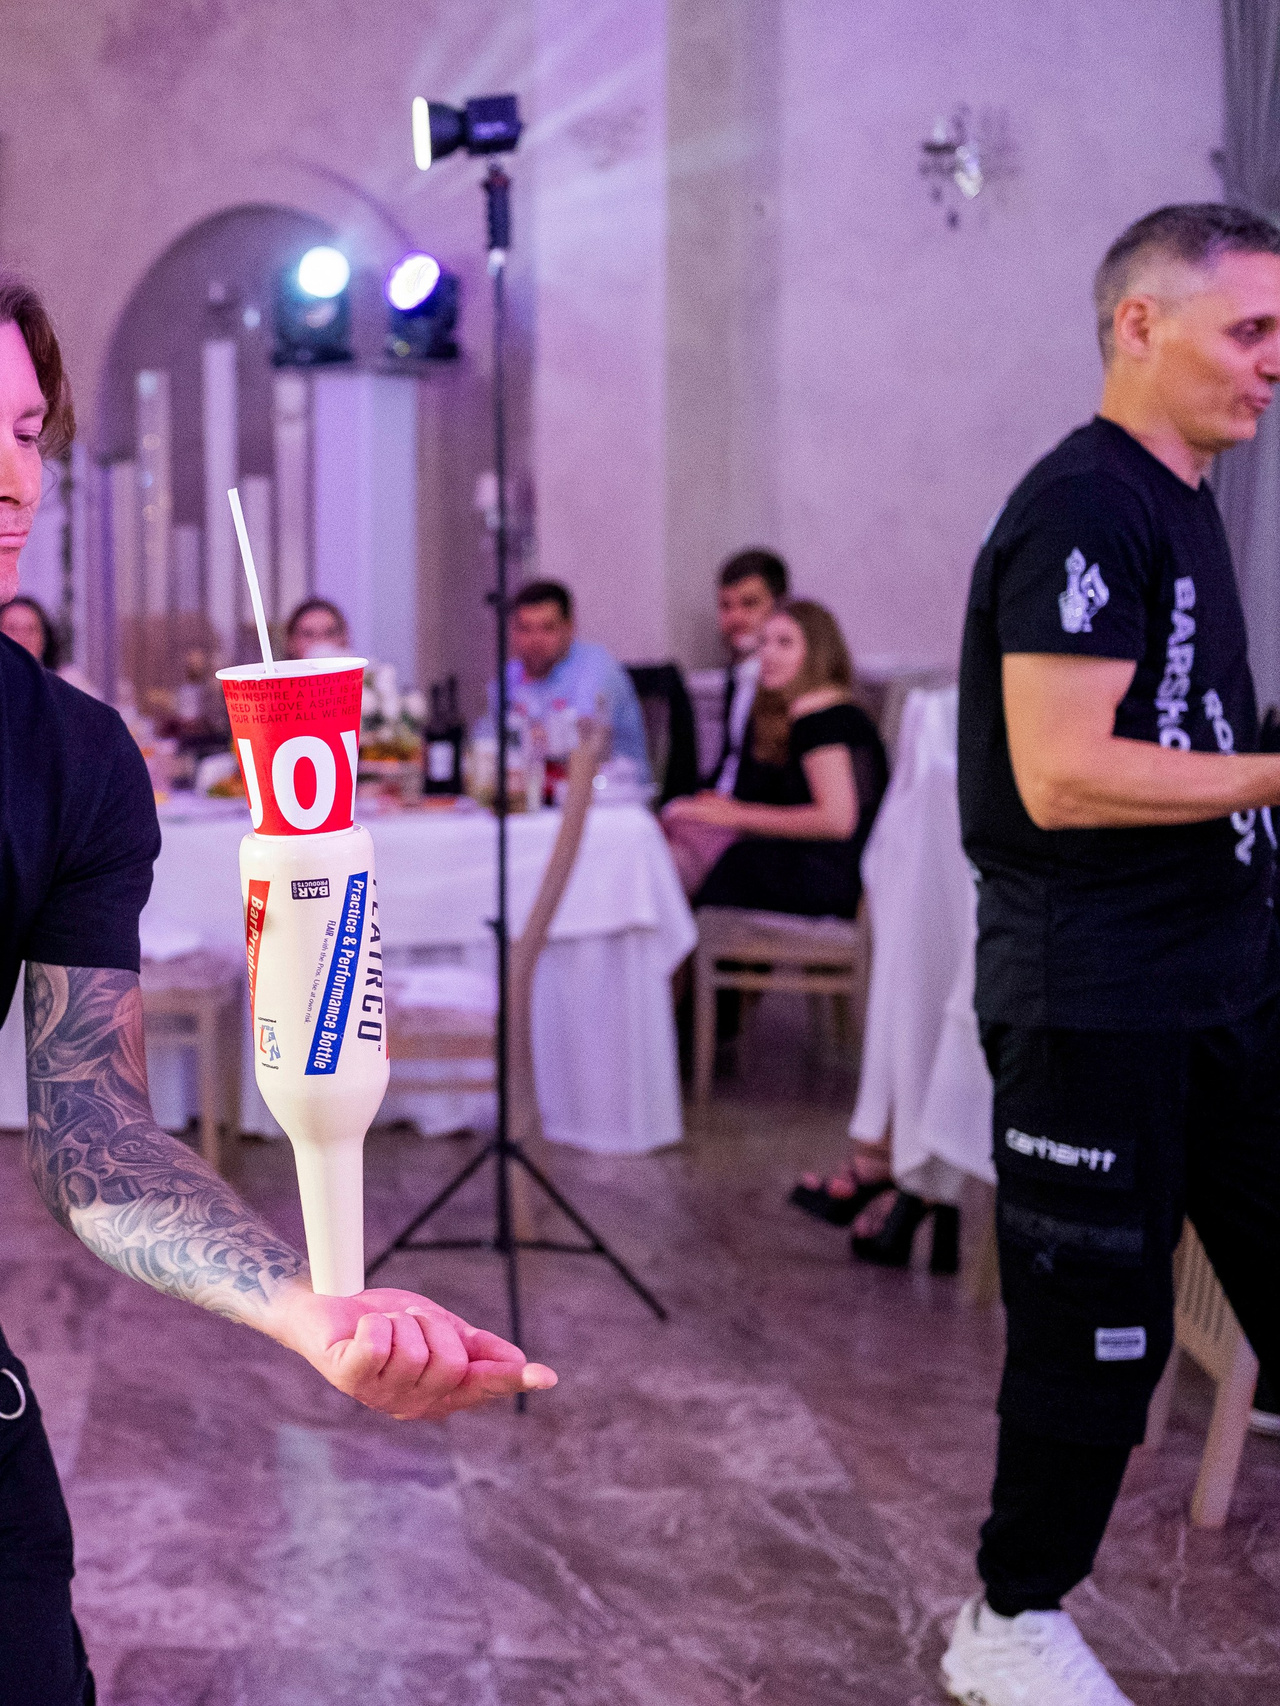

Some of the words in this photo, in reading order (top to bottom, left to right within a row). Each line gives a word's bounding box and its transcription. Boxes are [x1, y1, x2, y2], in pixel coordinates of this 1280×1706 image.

[1154, 576, 1196, 751] BARSHO
[233, 679, 283, 691] MOMENT
[290, 675, 341, 688] FOLLOW
[242, 691, 290, 702] INSPIRE
[296, 690, 305, 698] A
[311, 686, 335, 698] LIFE
[341, 685, 349, 694] IS
[255, 704, 266, 713] IS
[271, 701, 303, 712] LOVE
[310, 696, 348, 709] ASPIRE
[252, 712, 289, 724] HEART
[295, 712, 317, 721] ALL
[322, 709, 337, 718] WE
[297, 880, 328, 888] PRODUCTS
[298, 886, 329, 898] BAR
[345, 880, 365, 933] Practice
[325, 919, 336, 937] FLAIR
[321, 938, 329, 951] with
[342, 936, 355, 947] &
[318, 952, 327, 962] the
[312, 979, 321, 990] Use
[323, 948, 355, 1028] Performance
[306, 998, 314, 1012] own
[313, 1031, 337, 1070] Bottle
